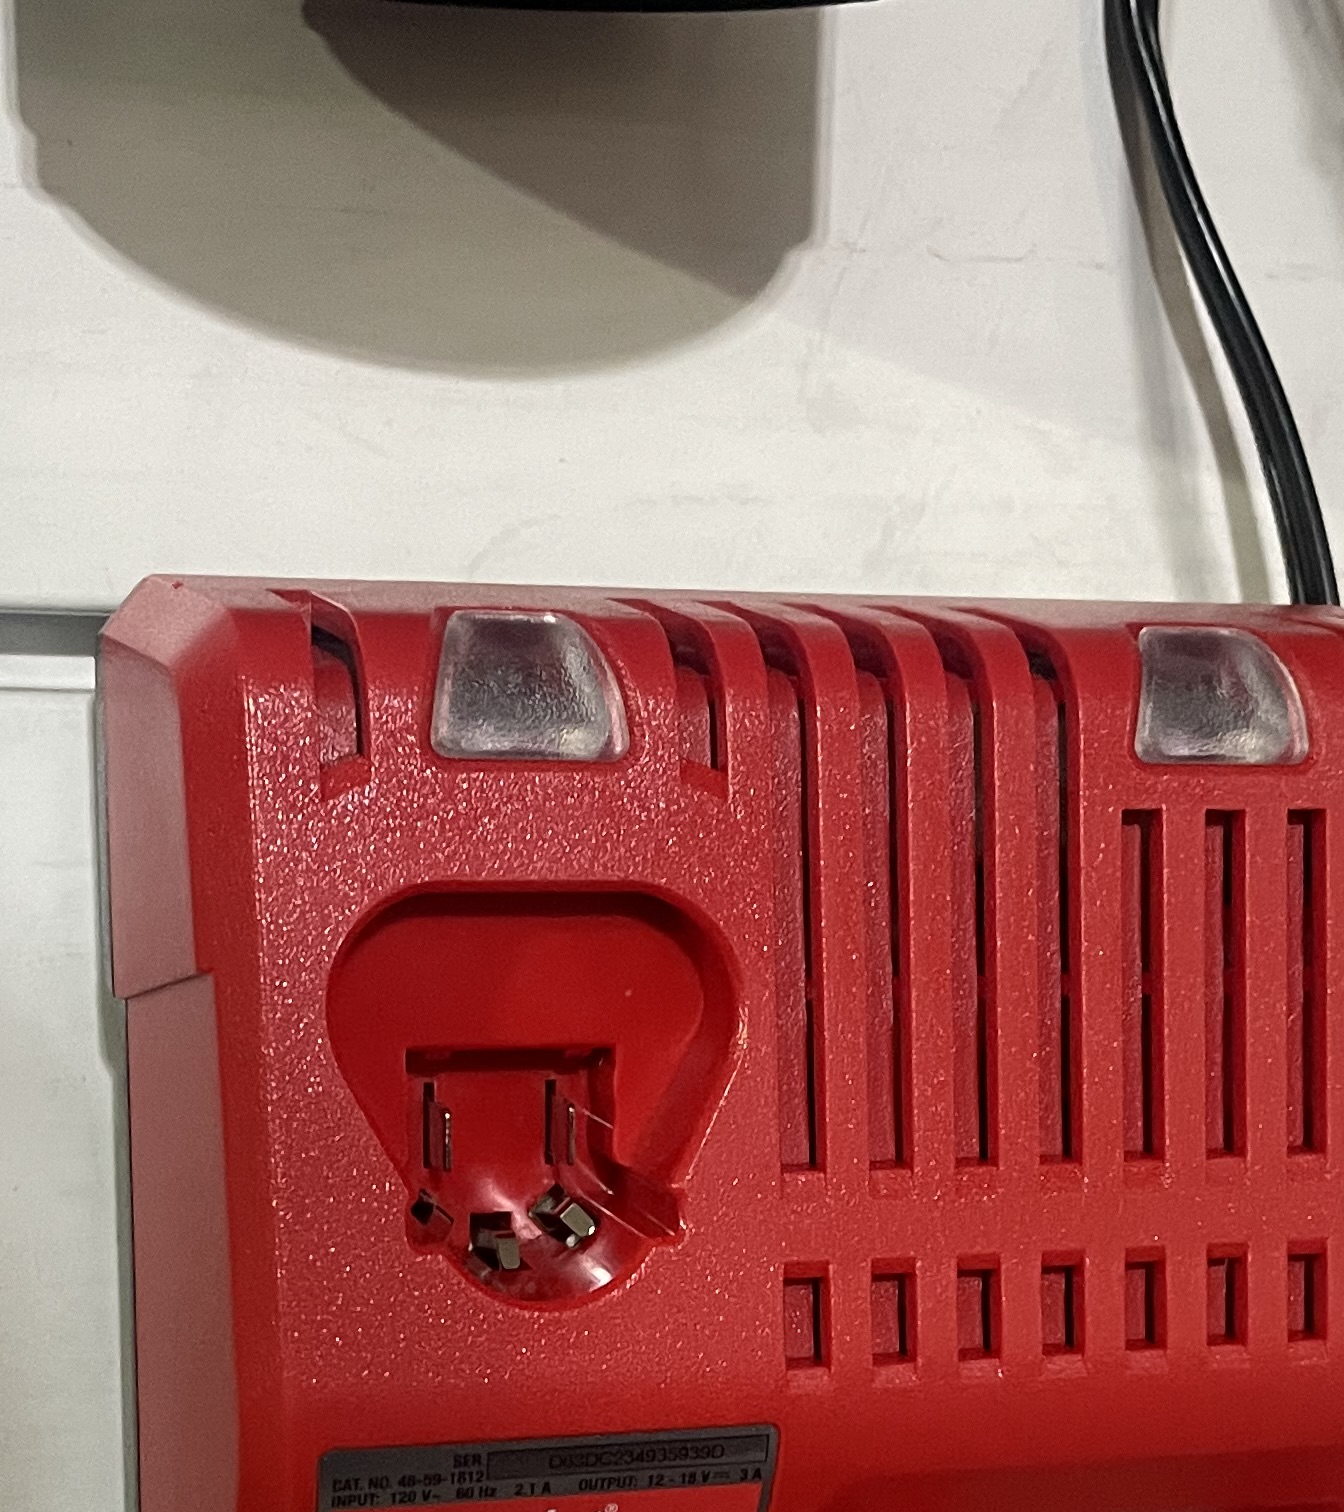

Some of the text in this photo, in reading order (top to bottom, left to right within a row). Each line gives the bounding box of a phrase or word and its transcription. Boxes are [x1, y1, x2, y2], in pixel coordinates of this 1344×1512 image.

[453, 1453, 482, 1468] SER
[397, 1471, 484, 1487] 48-59-1812
[331, 1493, 380, 1508] INPUT:
[390, 1490, 417, 1505] 120
[478, 1485, 498, 1498] Hz
[514, 1482, 536, 1496] 2.1
[541, 1481, 552, 1495] A
[578, 1475, 638, 1492] OUTPUT:
[647, 1474, 664, 1487] 12
[681, 1472, 697, 1484] 18
[740, 1468, 750, 1482] 3
[752, 1467, 762, 1480] A
